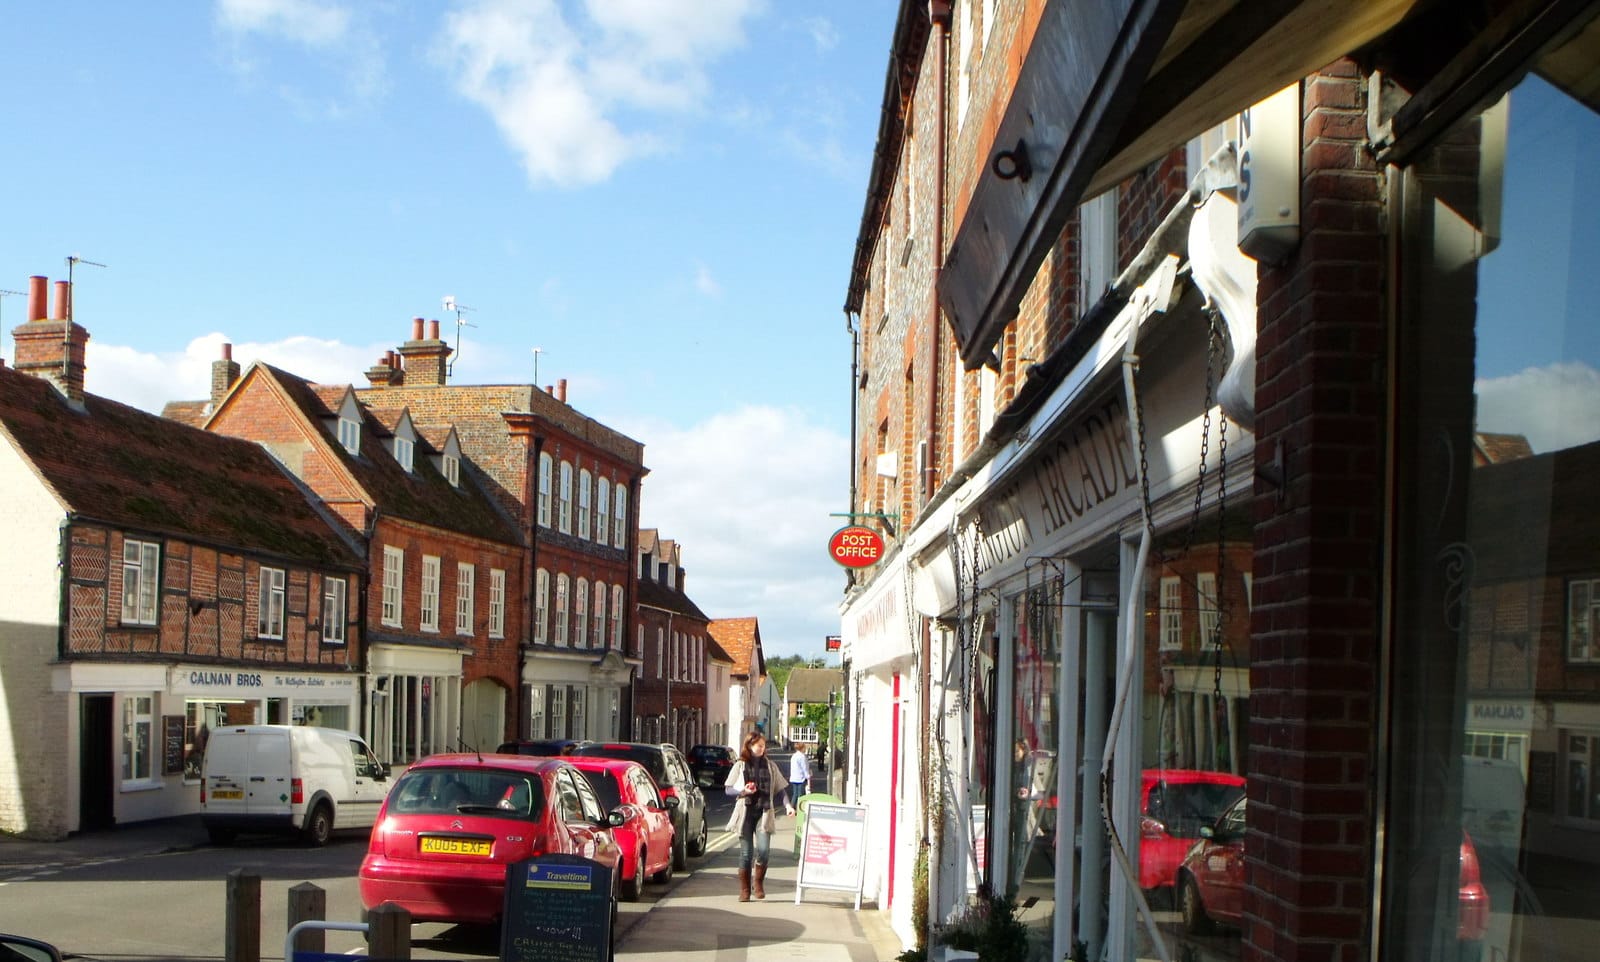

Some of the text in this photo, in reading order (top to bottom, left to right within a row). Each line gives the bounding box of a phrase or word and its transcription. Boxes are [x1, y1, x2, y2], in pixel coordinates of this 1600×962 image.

[1034, 396, 1138, 536] ARCADE
[842, 535, 873, 546] POST
[835, 546, 877, 558] OFFICE
[190, 671, 232, 686] CALNAN
[236, 673, 264, 688] BROS.
[461, 840, 484, 853] EXF
[546, 871, 588, 881] Traveltime
